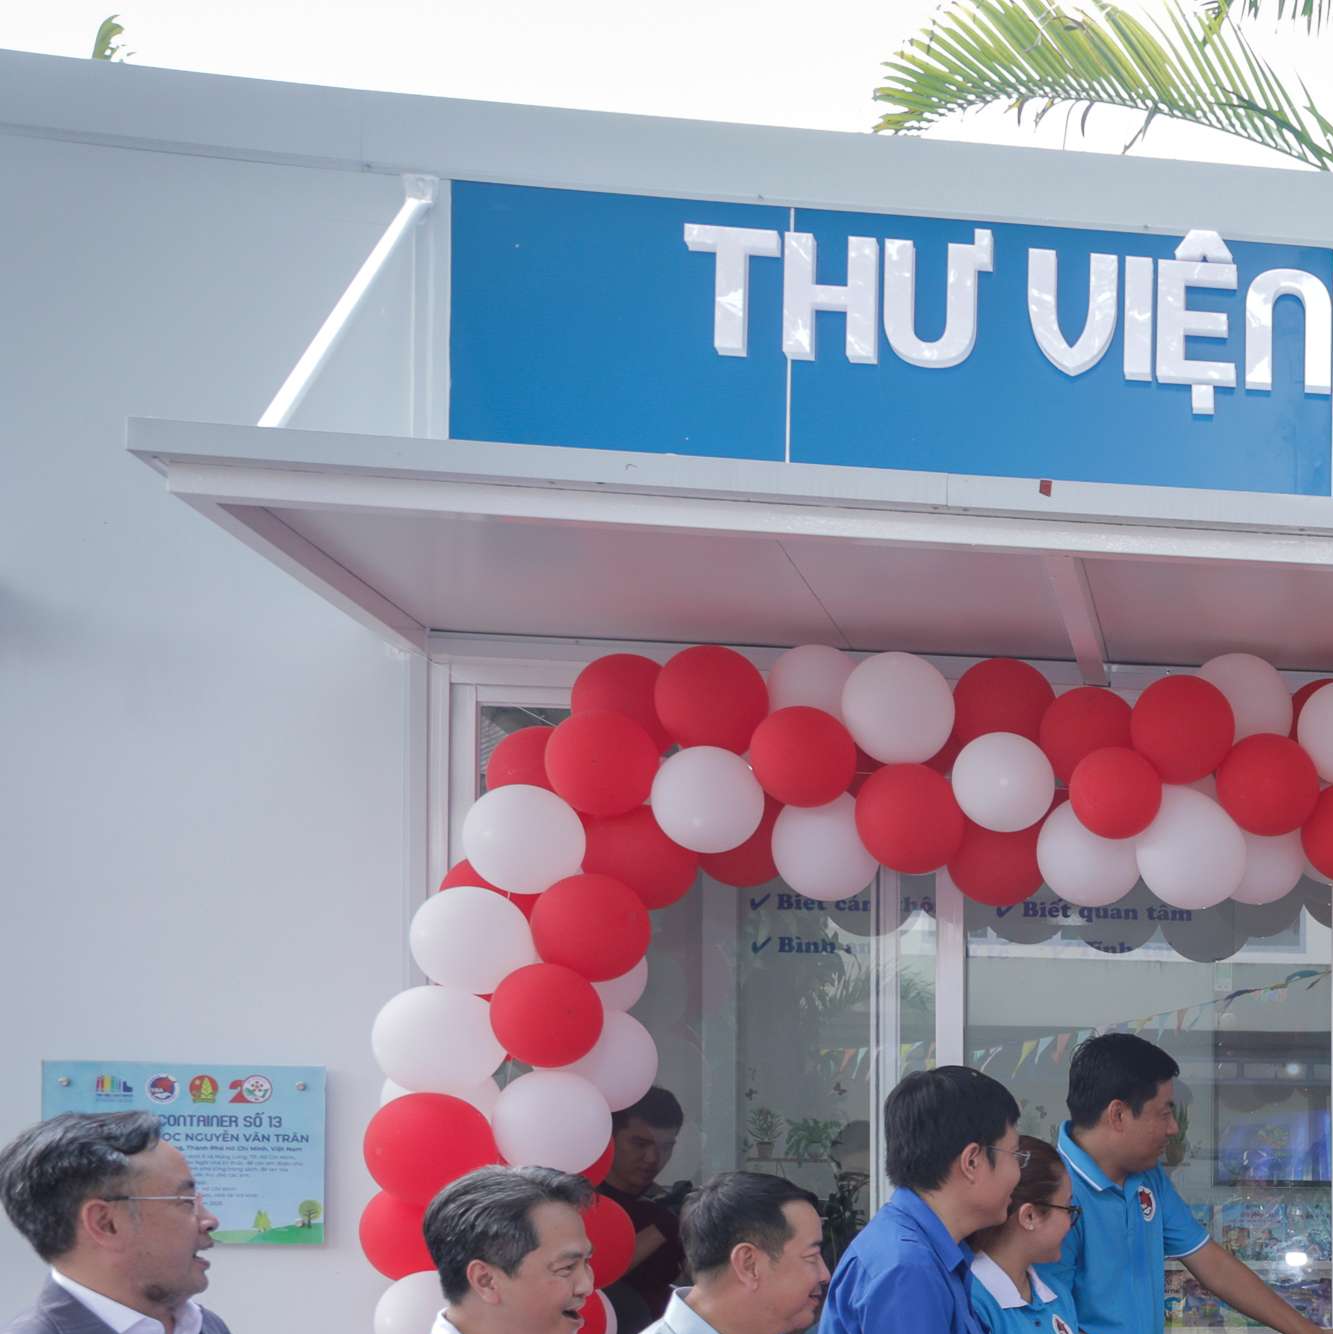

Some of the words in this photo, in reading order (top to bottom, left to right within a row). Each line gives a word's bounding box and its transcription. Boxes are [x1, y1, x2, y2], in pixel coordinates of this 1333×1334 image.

[683, 223, 995, 368] THƯ
[1023, 899, 1072, 918] Biết
[1079, 906, 1139, 922] quan
[1147, 906, 1193, 921] tâm
[158, 1113, 239, 1128] CONTAINER
[243, 1111, 265, 1128] SỐ
[268, 1115, 283, 1129] 13
